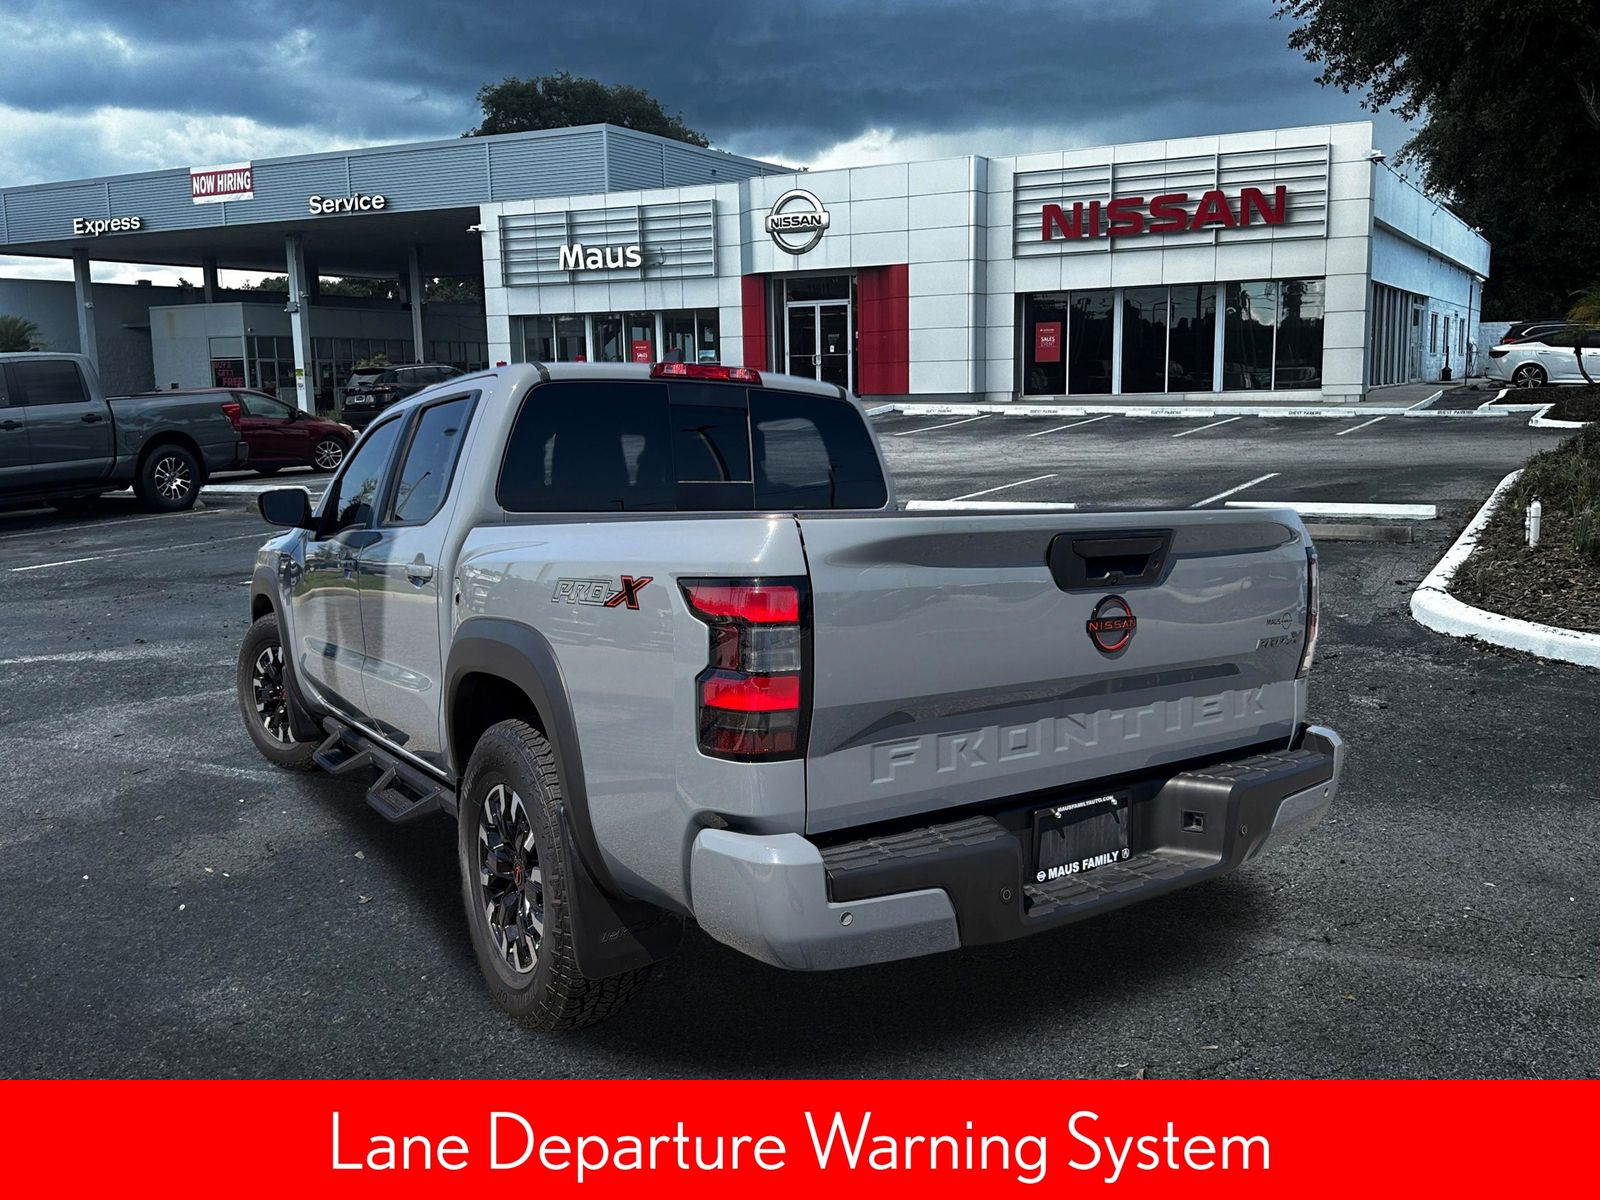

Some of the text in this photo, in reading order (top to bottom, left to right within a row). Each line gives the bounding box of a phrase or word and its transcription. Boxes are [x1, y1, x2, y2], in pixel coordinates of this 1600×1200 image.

[192, 171, 251, 195] NOW HIRING
[309, 192, 385, 215] Service
[1042, 185, 1287, 241] NISSAN
[73, 216, 141, 237] Express
[770, 214, 822, 228] NISSAN
[559, 243, 642, 271] Maus
[1088, 618, 1137, 632] NISSAN
[871, 685, 1268, 785] FRONTIER
[1057, 795, 1114, 812] MAUSFAMILYAUTO.COM
[1048, 862, 1079, 880] MAUS
[1082, 850, 1119, 871] FAMILY
